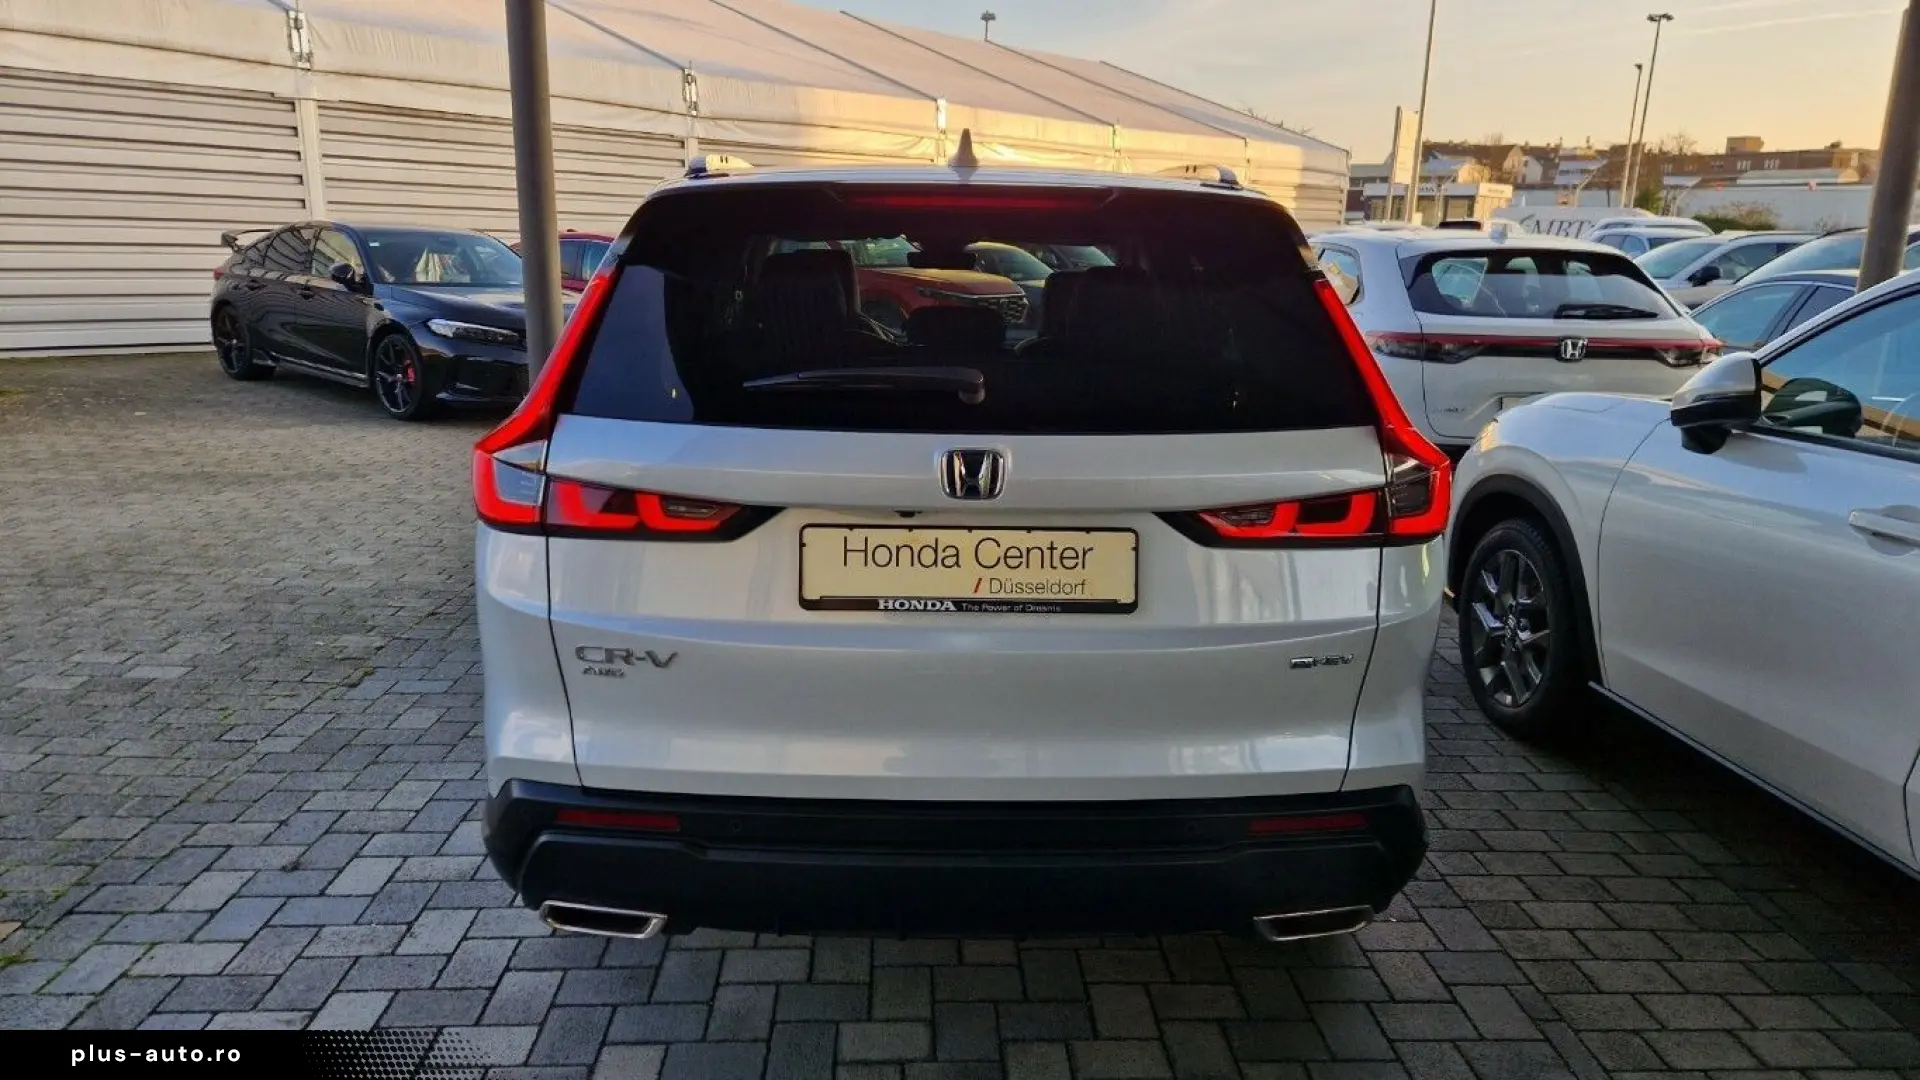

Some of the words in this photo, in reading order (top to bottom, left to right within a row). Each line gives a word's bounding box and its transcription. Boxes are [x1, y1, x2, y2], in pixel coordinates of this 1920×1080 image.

[843, 536, 961, 569] Honda
[974, 537, 1094, 570] Center
[989, 577, 1086, 596] Düsseldorf
[878, 599, 957, 612] HONDA
[575, 645, 678, 668] CR-V
